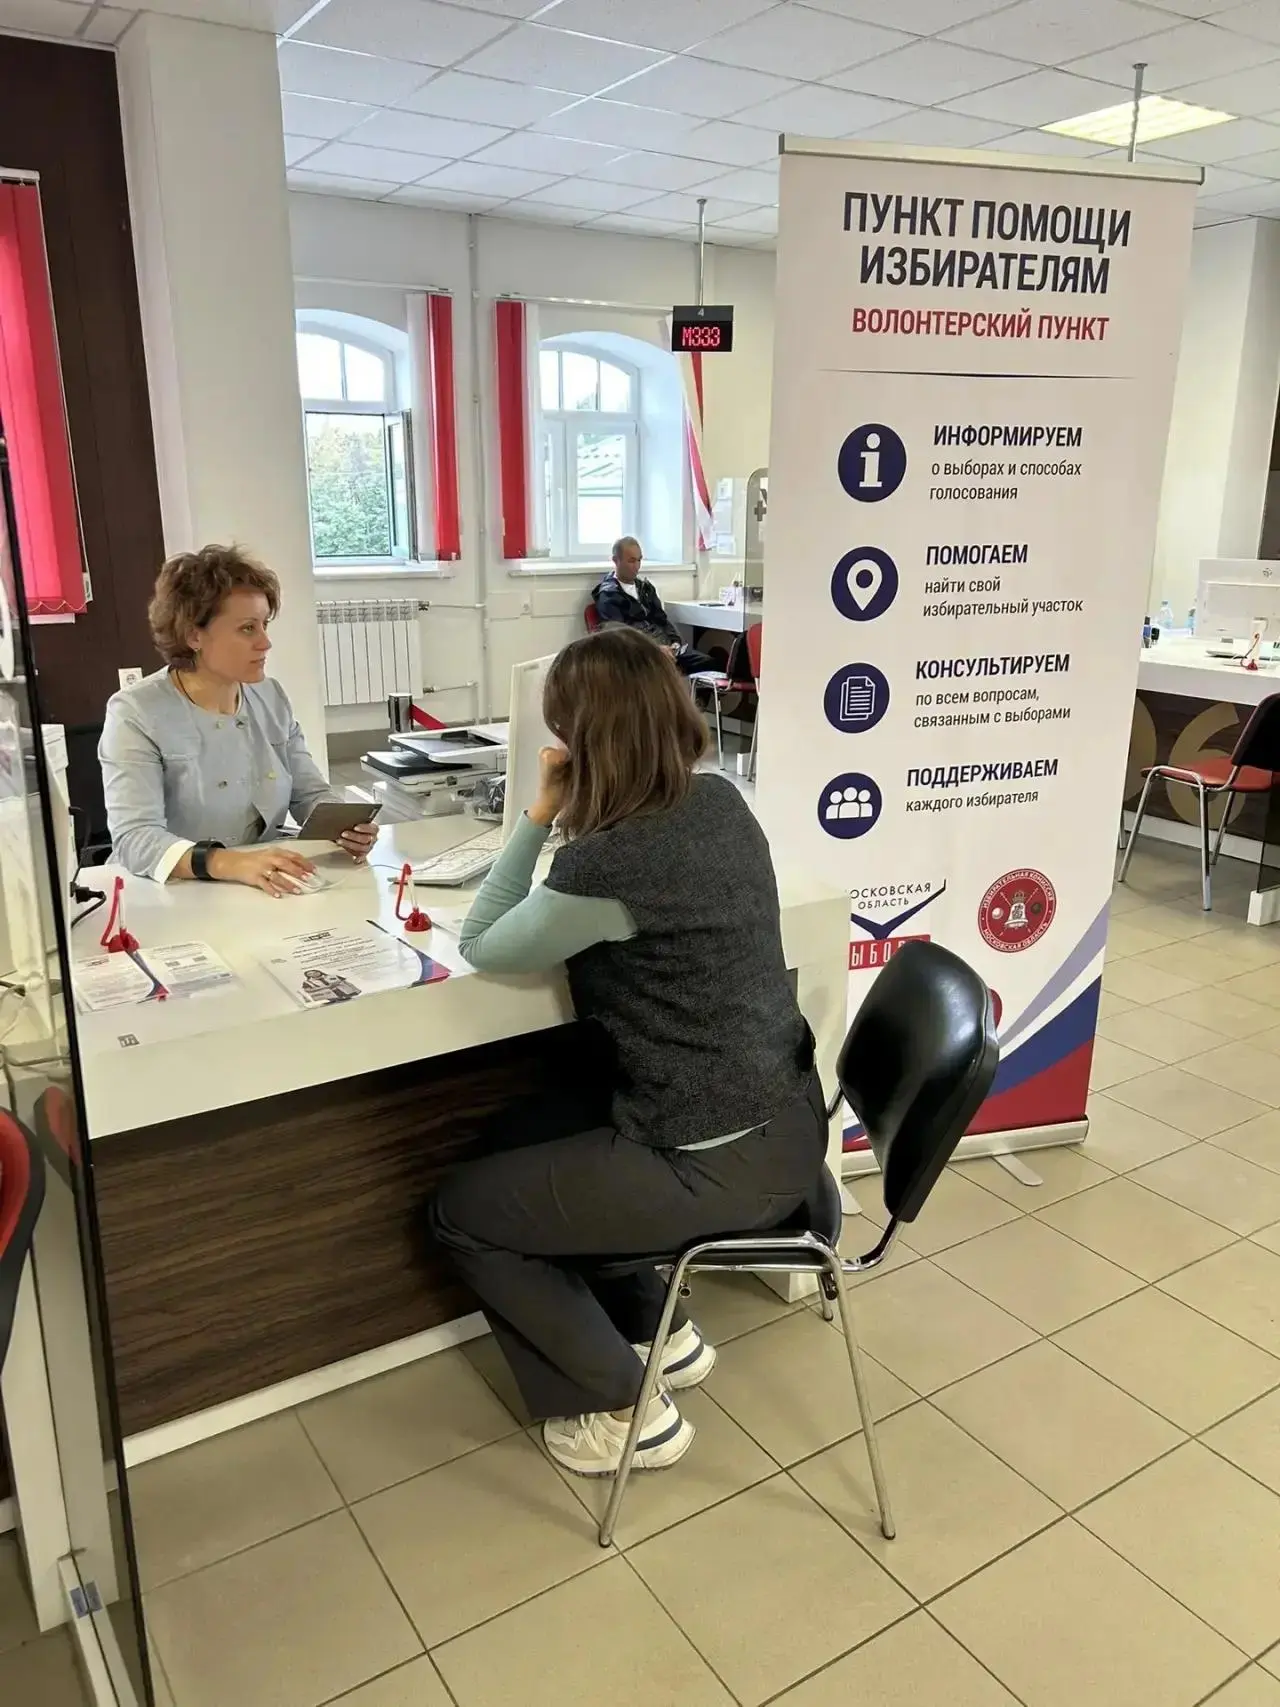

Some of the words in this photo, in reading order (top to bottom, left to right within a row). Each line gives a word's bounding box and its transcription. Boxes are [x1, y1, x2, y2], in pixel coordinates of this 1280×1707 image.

[843, 192, 964, 238] ПУНКТ
[971, 200, 1131, 254] ПОМОЩИ
[860, 245, 1110, 294] ИЗБИРАТЕЛЯМ
[697, 307, 704, 317] 4
[852, 307, 1031, 338] ВОЛОНТЕРСКИЙ
[1037, 315, 1109, 341] ПУНКТ
[933, 425, 1083, 447] ИНФОРМИРУЕМ
[931, 463, 941, 476] о
[944, 460, 1005, 479] выборах
[1008, 463, 1017, 475] и
[1020, 460, 1082, 478] способах
[929, 485, 1018, 501] голосования
[926, 544, 1029, 566] ПОМОГАЕМ
[924, 577, 965, 593] найти
[969, 576, 1001, 592] свой
[922, 599, 1029, 619] избирательный
[1031, 599, 1084, 617] участок
[915, 654, 1070, 680] КОНСУЛЬТИРУЕМ
[915, 693, 933, 707] по
[936, 691, 970, 705] всем
[973, 689, 1040, 707] вопросам,
[913, 711, 991, 728] связанным
[993, 711, 1002, 724] с
[1004, 707, 1071, 725] выборами
[907, 759, 1058, 788] ПОДДЕРЖИВАЕМ
[905, 795, 963, 812] каждого
[966, 790, 1039, 809] избирателя
[850, 882, 931, 899] ОСКОВСКАЯ
[858, 898, 909, 909] ОБЛАСТЬ
